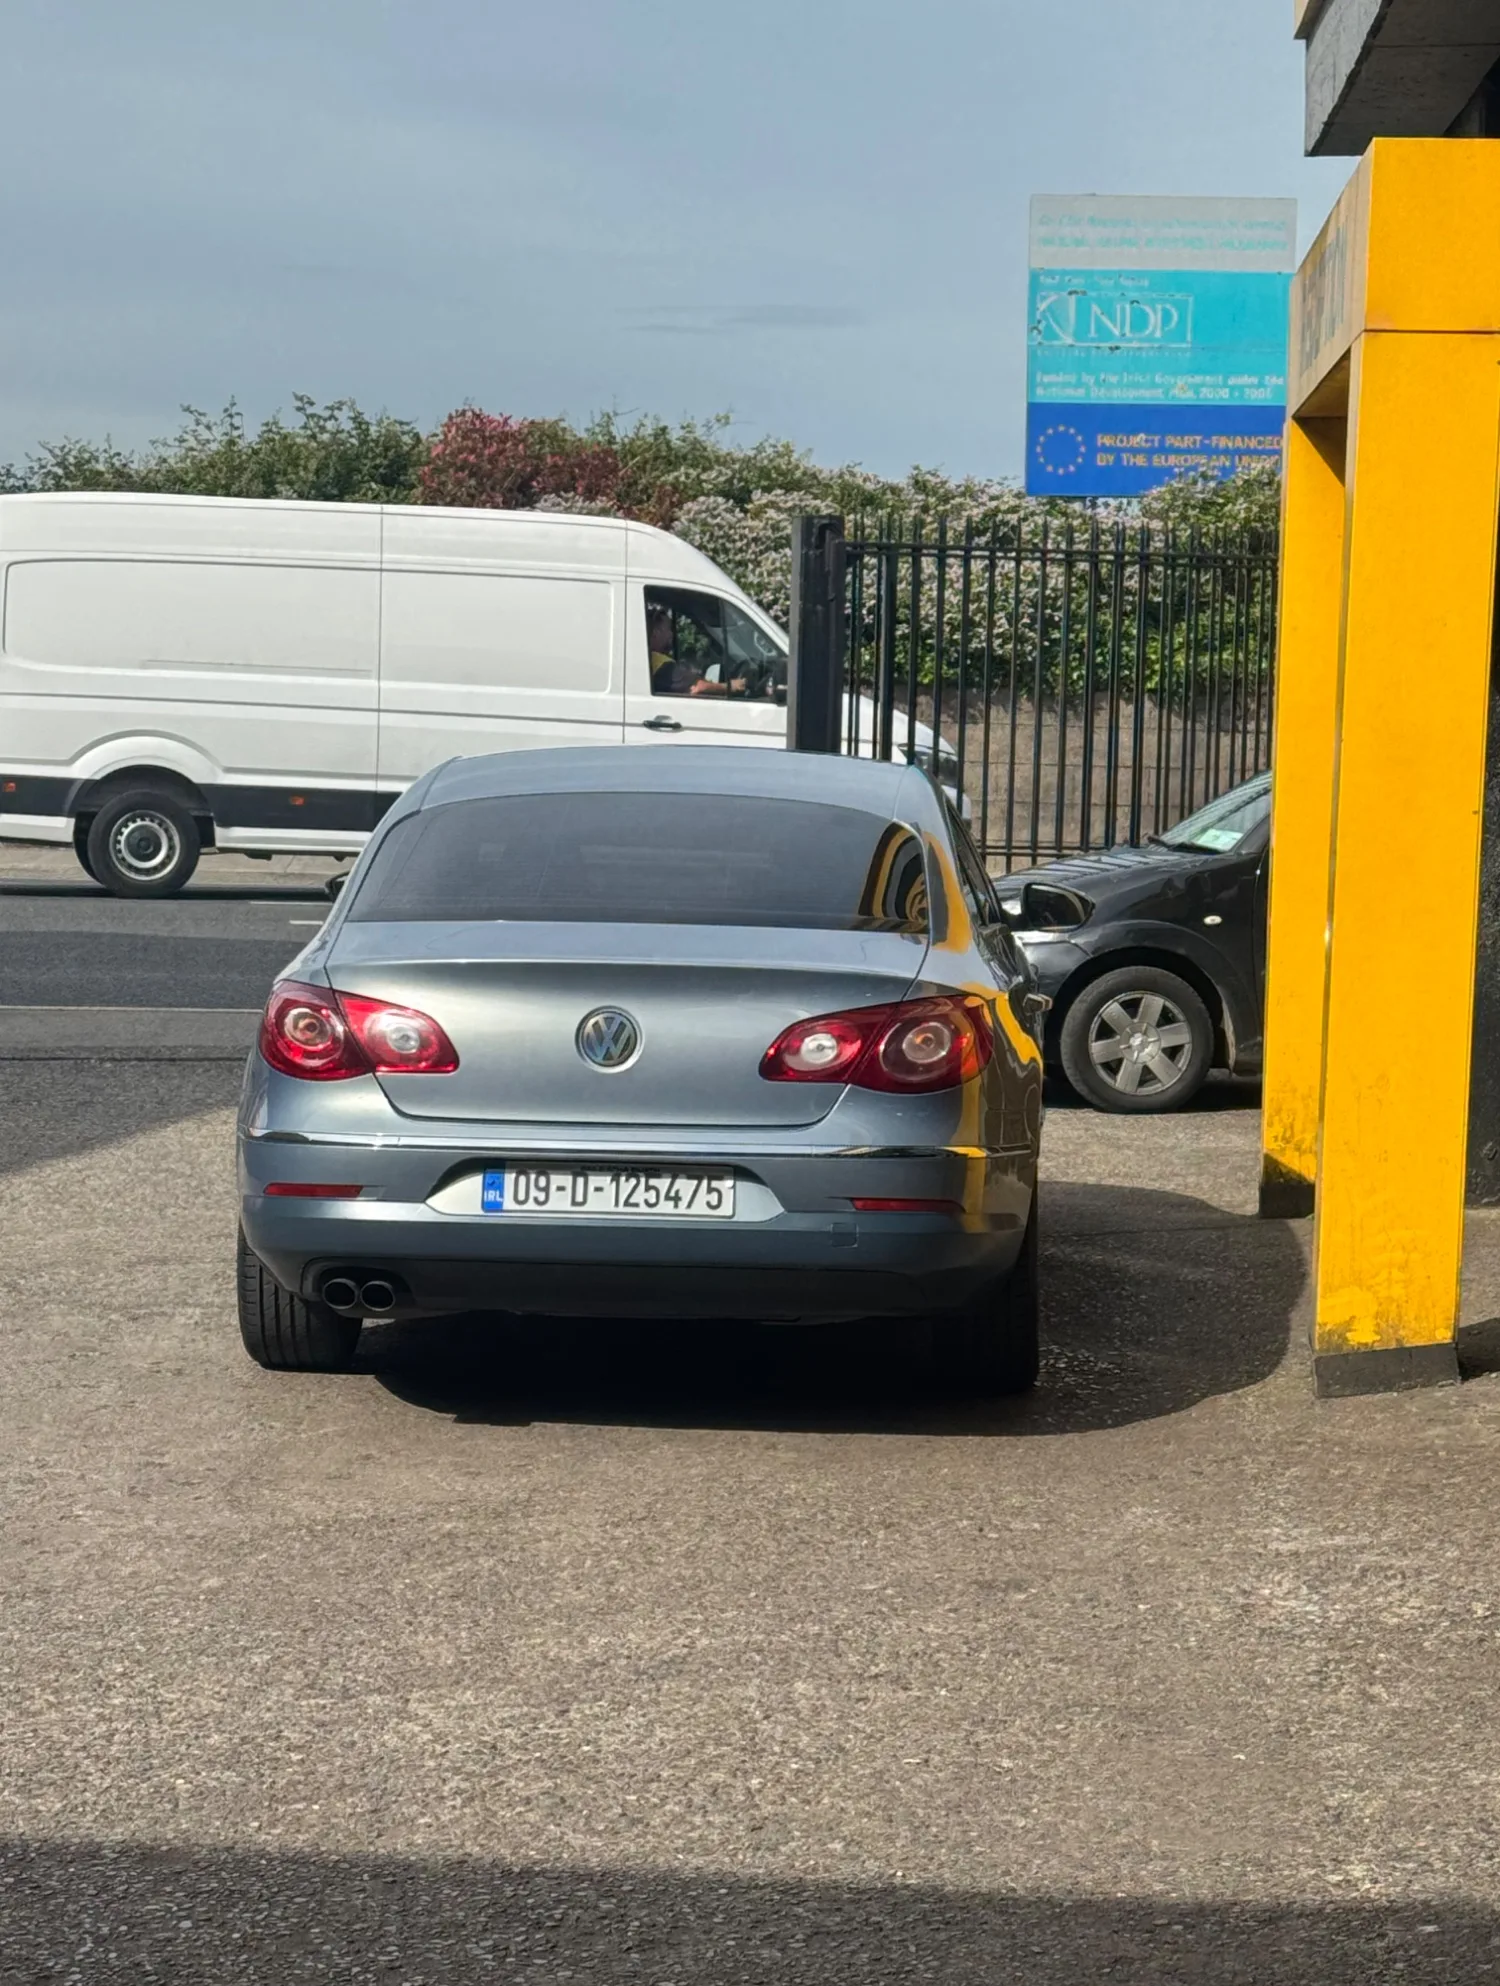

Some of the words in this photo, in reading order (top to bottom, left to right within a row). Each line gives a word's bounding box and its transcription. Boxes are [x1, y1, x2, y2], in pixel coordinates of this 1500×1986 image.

[1088, 301, 1179, 338] NDP
[1096, 433, 1161, 447] PROJECT
[1096, 453, 1115, 466] BY
[1120, 452, 1149, 467] THE
[1152, 454, 1231, 468] EUROPEAN
[484, 1190, 504, 1203] IRL
[513, 1169, 723, 1210] 09-D-125475
